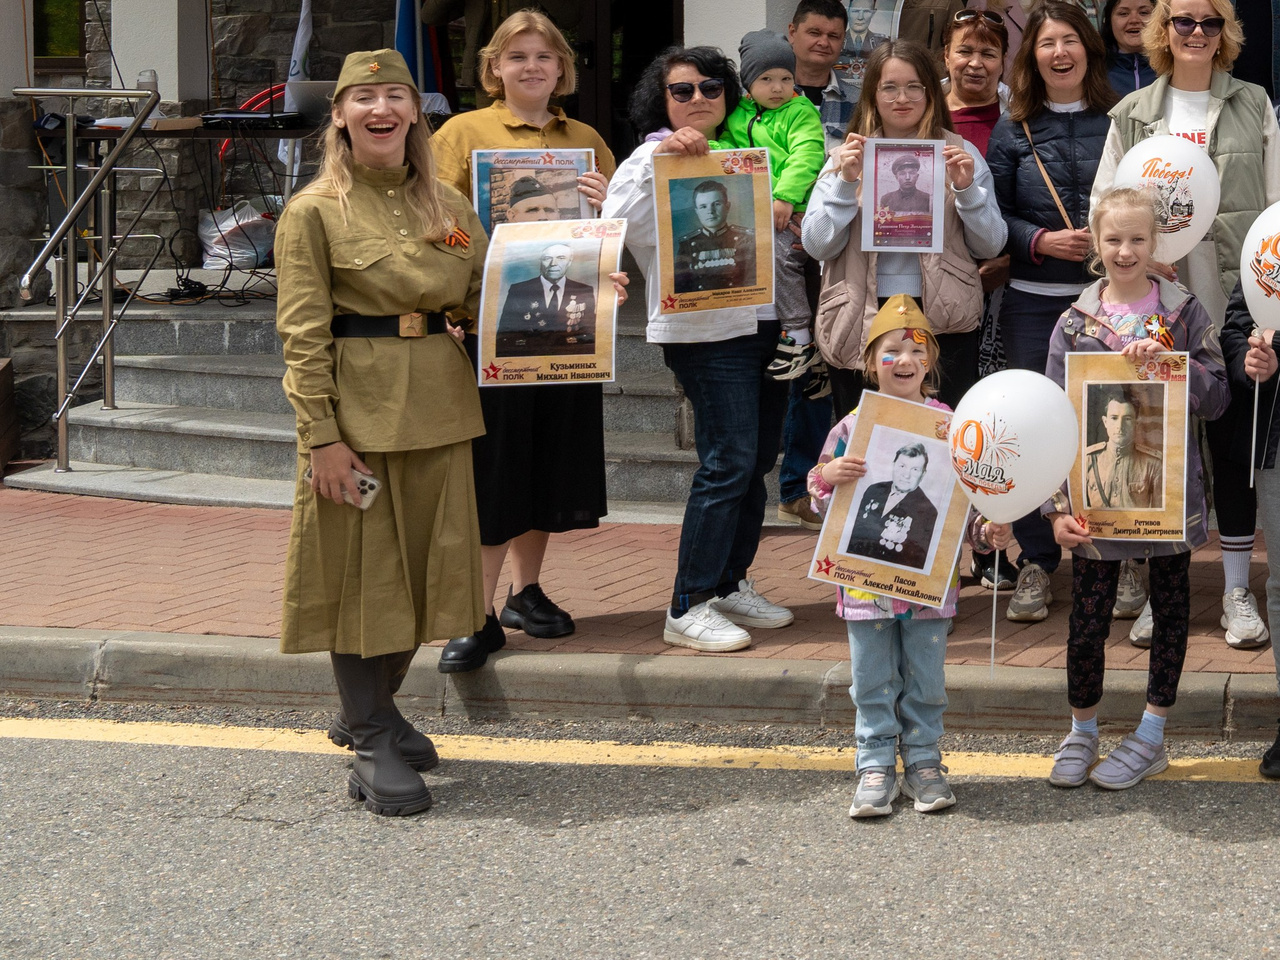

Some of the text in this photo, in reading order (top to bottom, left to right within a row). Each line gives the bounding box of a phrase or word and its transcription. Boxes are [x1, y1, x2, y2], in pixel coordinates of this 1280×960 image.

[743, 157, 753, 174] 9
[595, 225, 607, 238] 9
[550, 362, 597, 371] Кузьминых
[1160, 362, 1171, 381] 9
[536, 372, 610, 381] Михаил Иванович
[958, 419, 986, 463] 9
[1134, 519, 1161, 527] Ретивов
[1113, 527, 1183, 536] Дмитрий Дмитриевич
[833, 571, 856, 583] ПОЛК
[894, 575, 917, 587] Пасов
[862, 578, 942, 603] Алексей Михайлович
